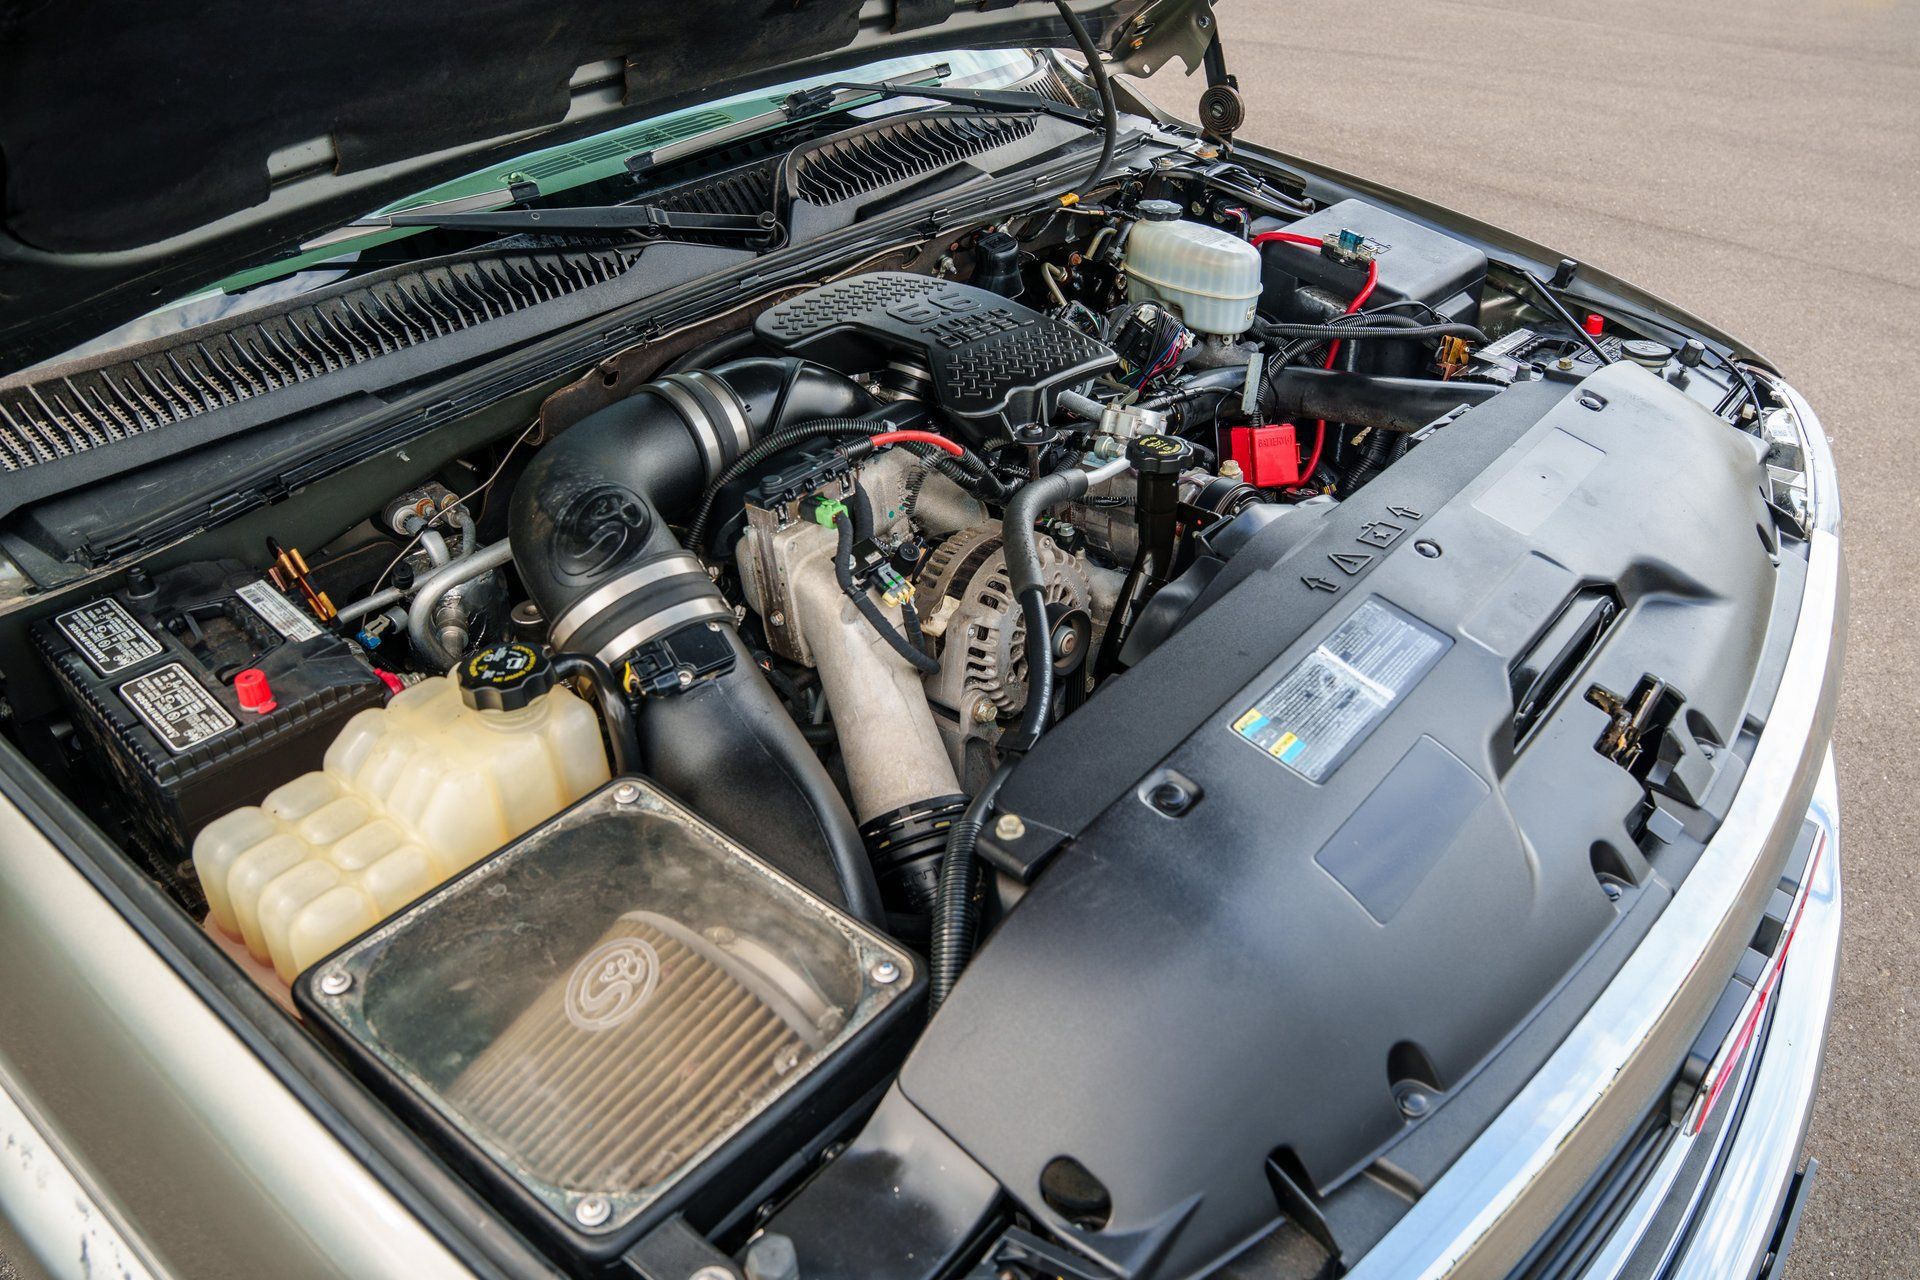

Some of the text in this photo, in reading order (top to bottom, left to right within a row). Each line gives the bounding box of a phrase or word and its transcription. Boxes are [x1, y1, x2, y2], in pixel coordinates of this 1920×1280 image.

[886, 292, 982, 325] 6.6
[920, 307, 1013, 336] TURBO
[935, 317, 1035, 348] DIESEL
